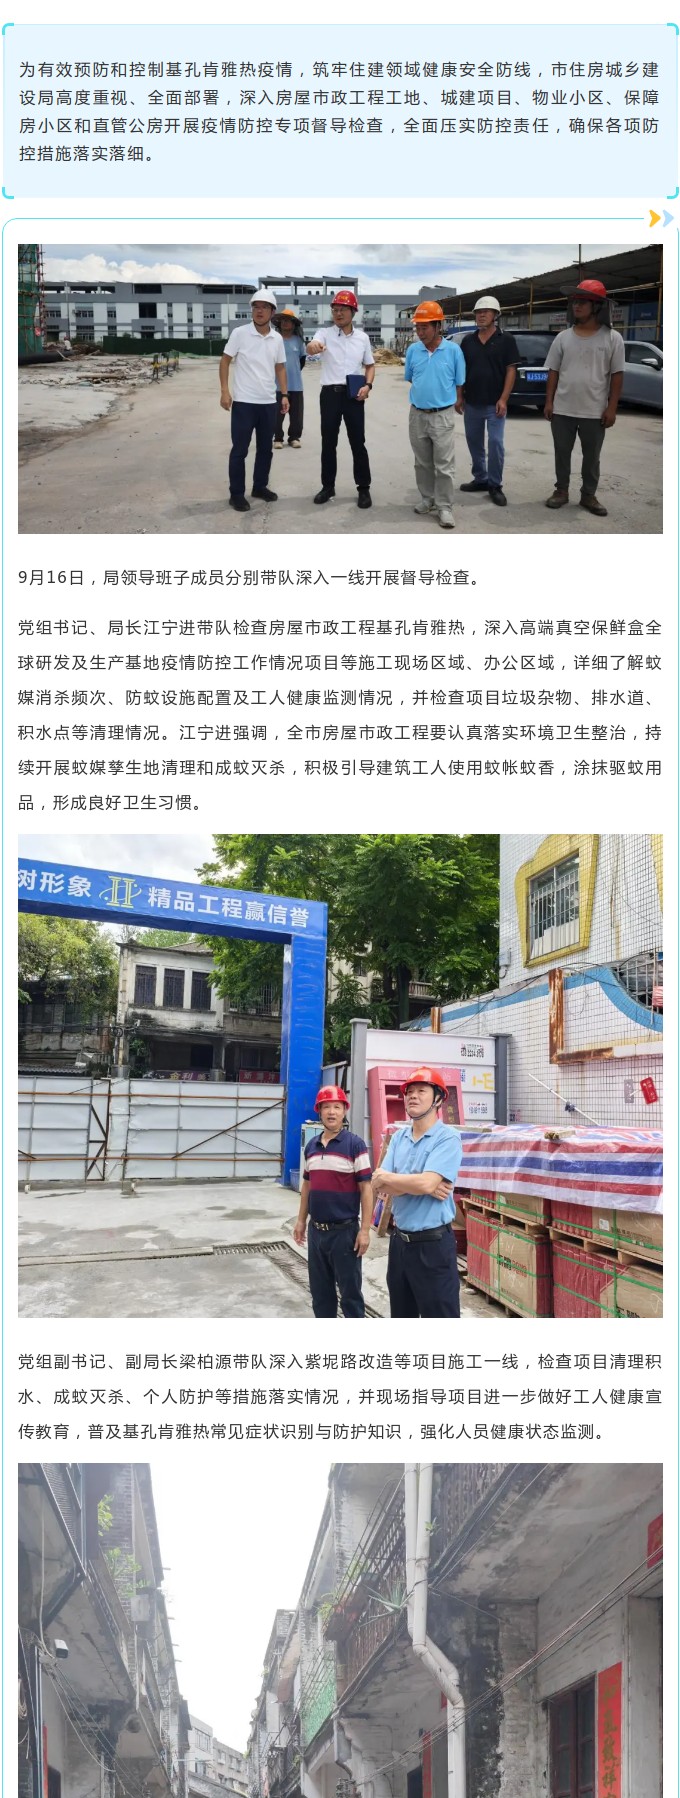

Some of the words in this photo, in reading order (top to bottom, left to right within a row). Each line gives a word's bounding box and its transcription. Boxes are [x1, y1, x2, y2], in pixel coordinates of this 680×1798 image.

[18, 869, 92, 898] 树形象
[148, 886, 309, 929] 精品工程赢信誉
